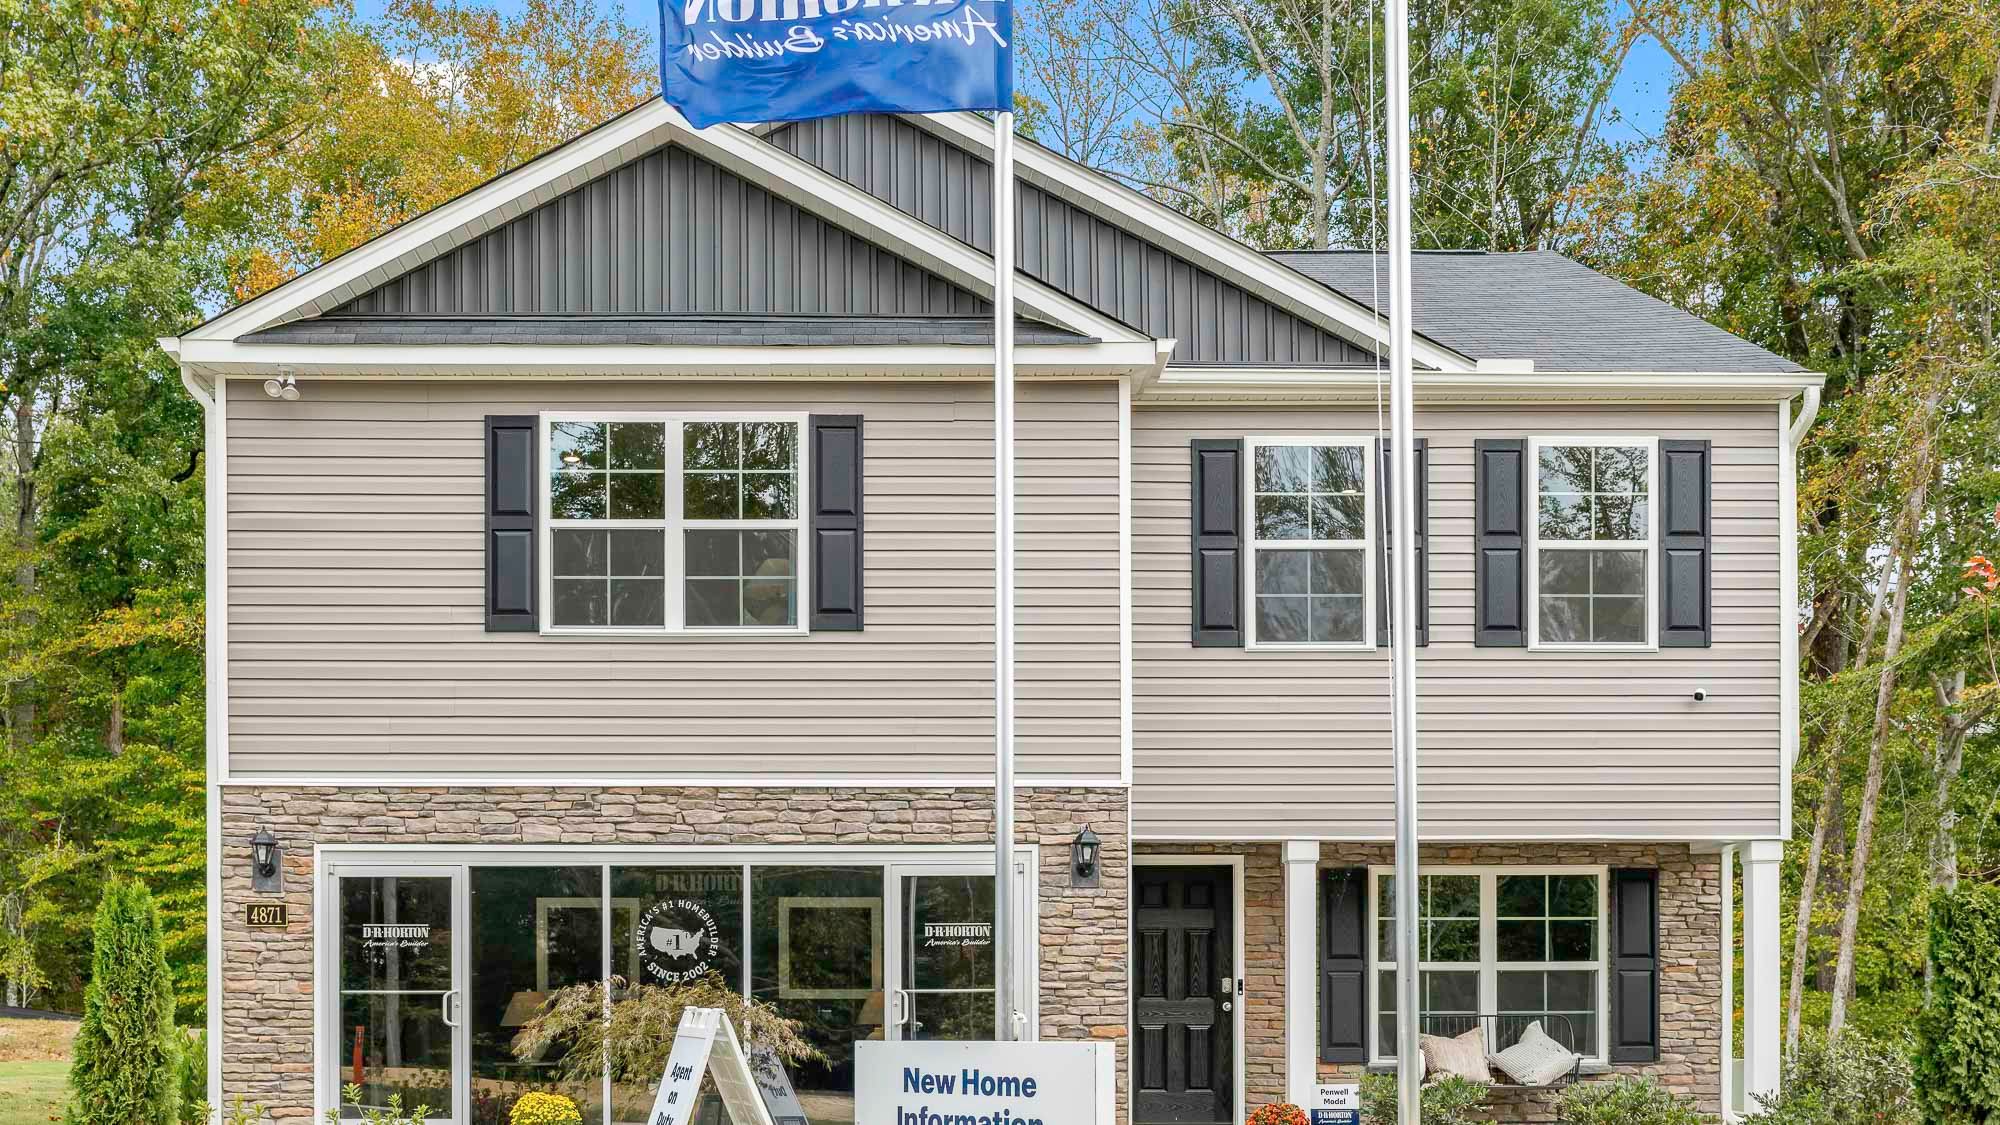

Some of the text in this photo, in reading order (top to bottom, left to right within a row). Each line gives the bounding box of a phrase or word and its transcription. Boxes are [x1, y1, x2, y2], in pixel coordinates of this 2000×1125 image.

[251, 906, 282, 923] 4871
[636, 899, 719, 957] AMERICA'S #1 HOMEBUILDER
[666, 934, 683, 950] #1
[647, 961, 709, 981] SINCE 2002
[670, 1062, 693, 1083] Agent
[903, 1067, 1037, 1098] New Home
[667, 1091, 678, 1105] on
[1320, 1088, 1349, 1096] Penwell
